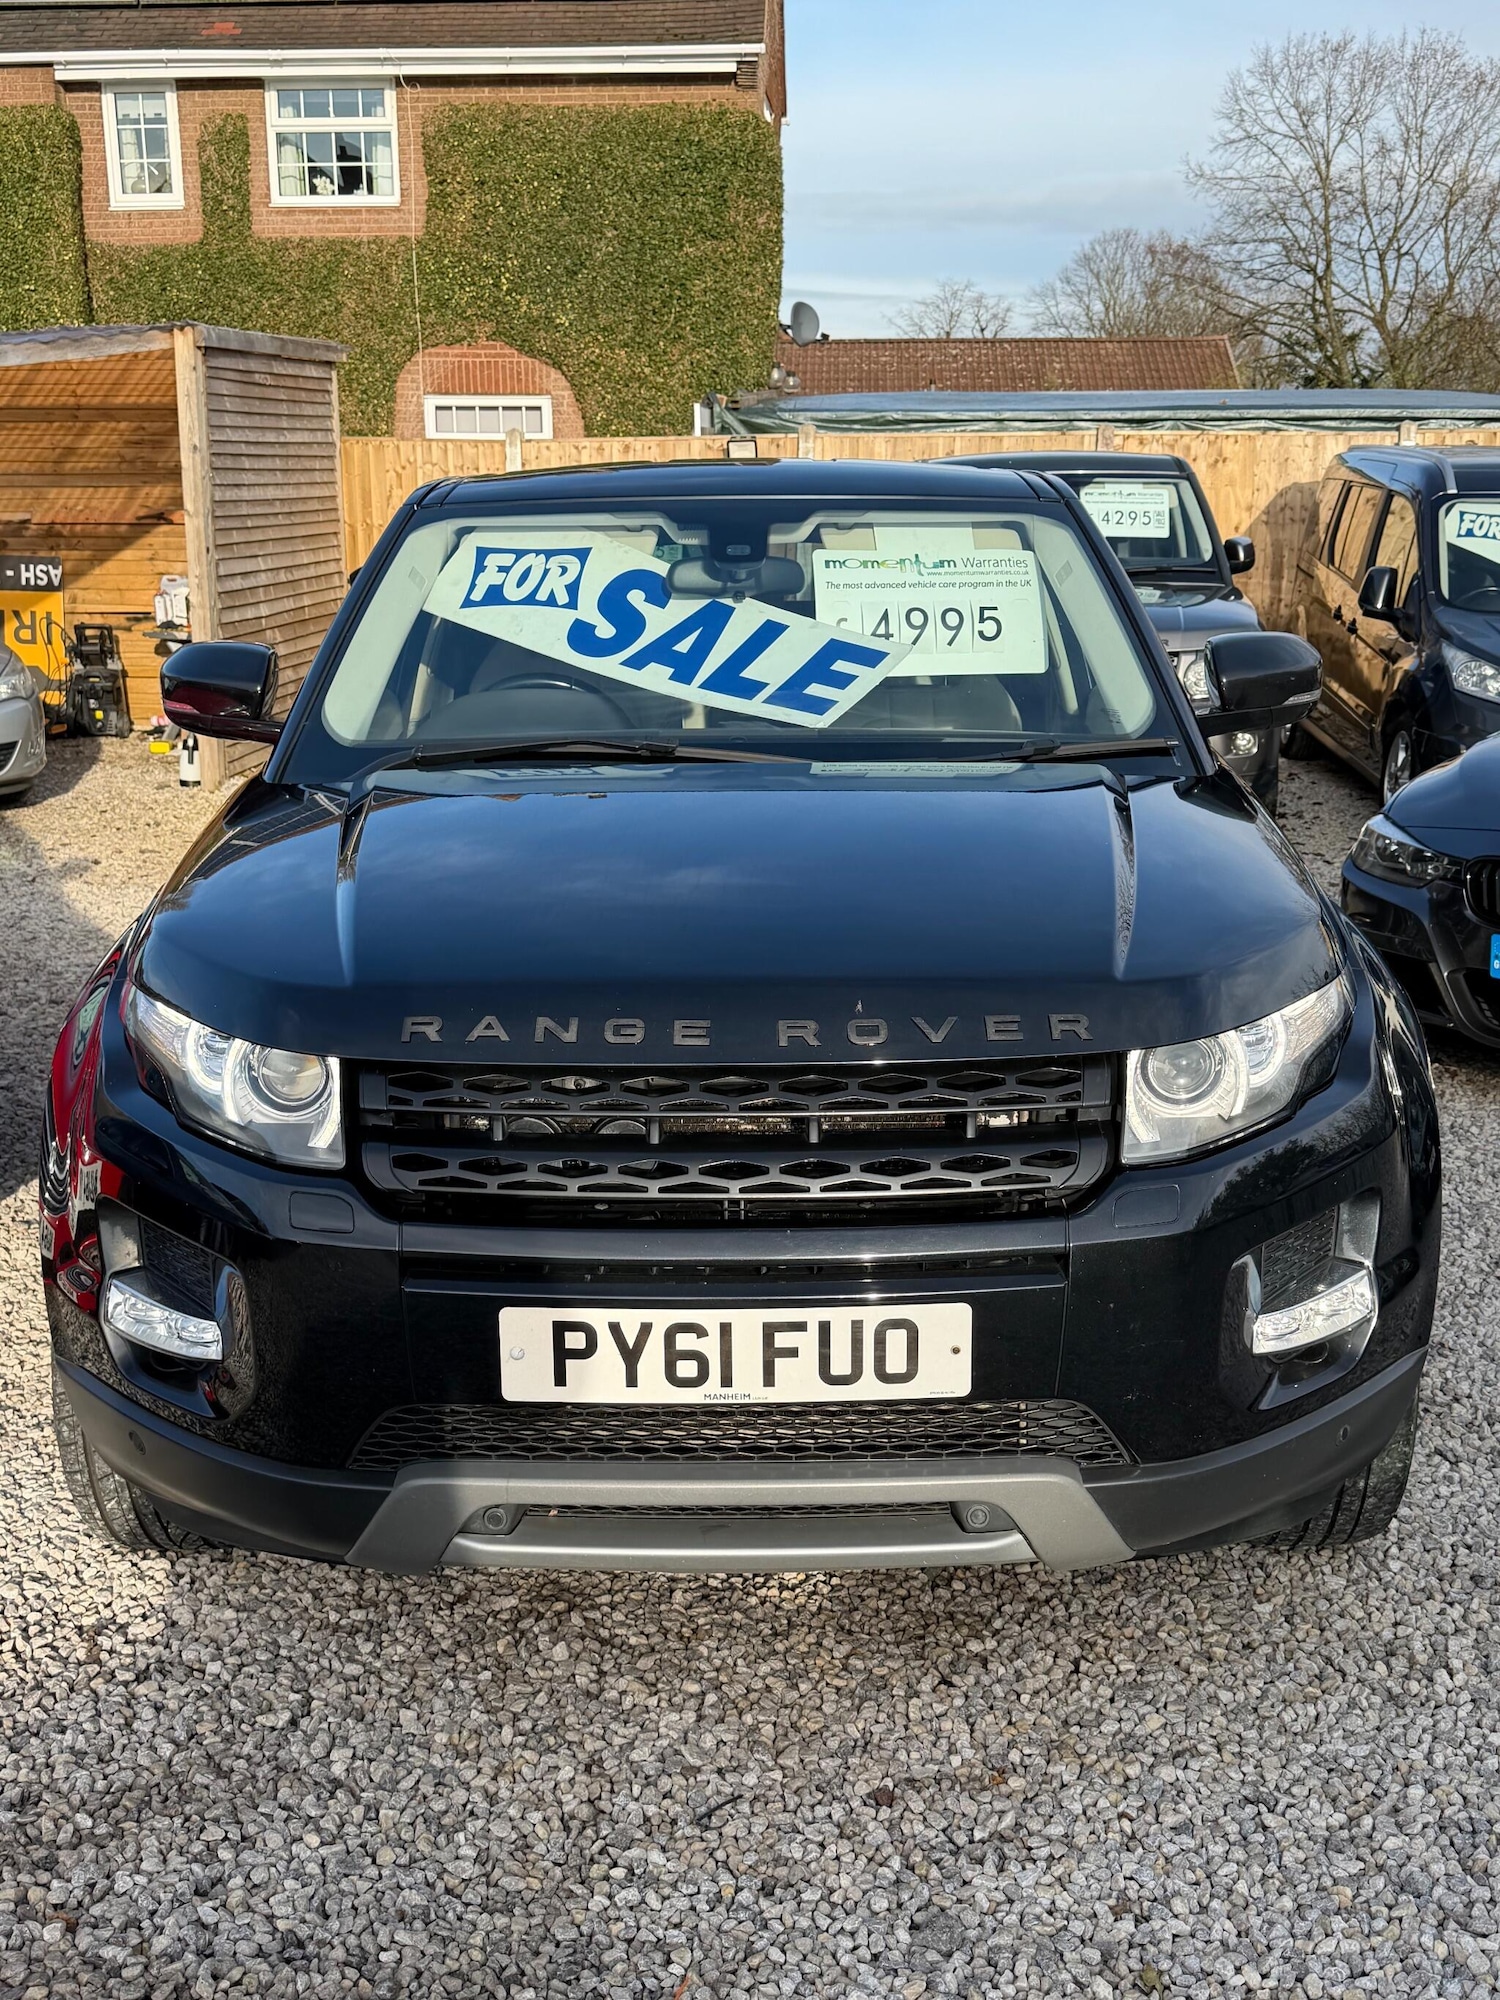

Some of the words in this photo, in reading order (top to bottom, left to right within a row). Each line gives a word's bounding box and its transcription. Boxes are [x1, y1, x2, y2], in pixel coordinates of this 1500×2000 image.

[1458, 512, 1500, 540] FOR
[20, 564, 62, 587] ASH
[824, 553, 957, 577] momentum
[961, 556, 1029, 569] Warranties
[926, 569, 1030, 577] www.momentumwarranties.co.uk
[825, 580, 842, 590] The
[842, 581, 864, 590] most
[864, 580, 907, 590] advanced
[907, 580, 937, 589] vehicle
[938, 581, 957, 589] care
[958, 580, 995, 590] program
[995, 579, 1004, 588] in
[1005, 578, 1019, 588] the
[1019, 578, 1032, 588] UK
[474, 552, 581, 606] FOR
[567, 568, 891, 716] SALE
[401, 1015, 712, 1047] RANGE
[777, 1013, 1095, 1048] ROVER
[551, 1320, 734, 1389] PY61
[761, 1317, 920, 1388] FUO
[703, 1393, 751, 1401] MANHEIM
